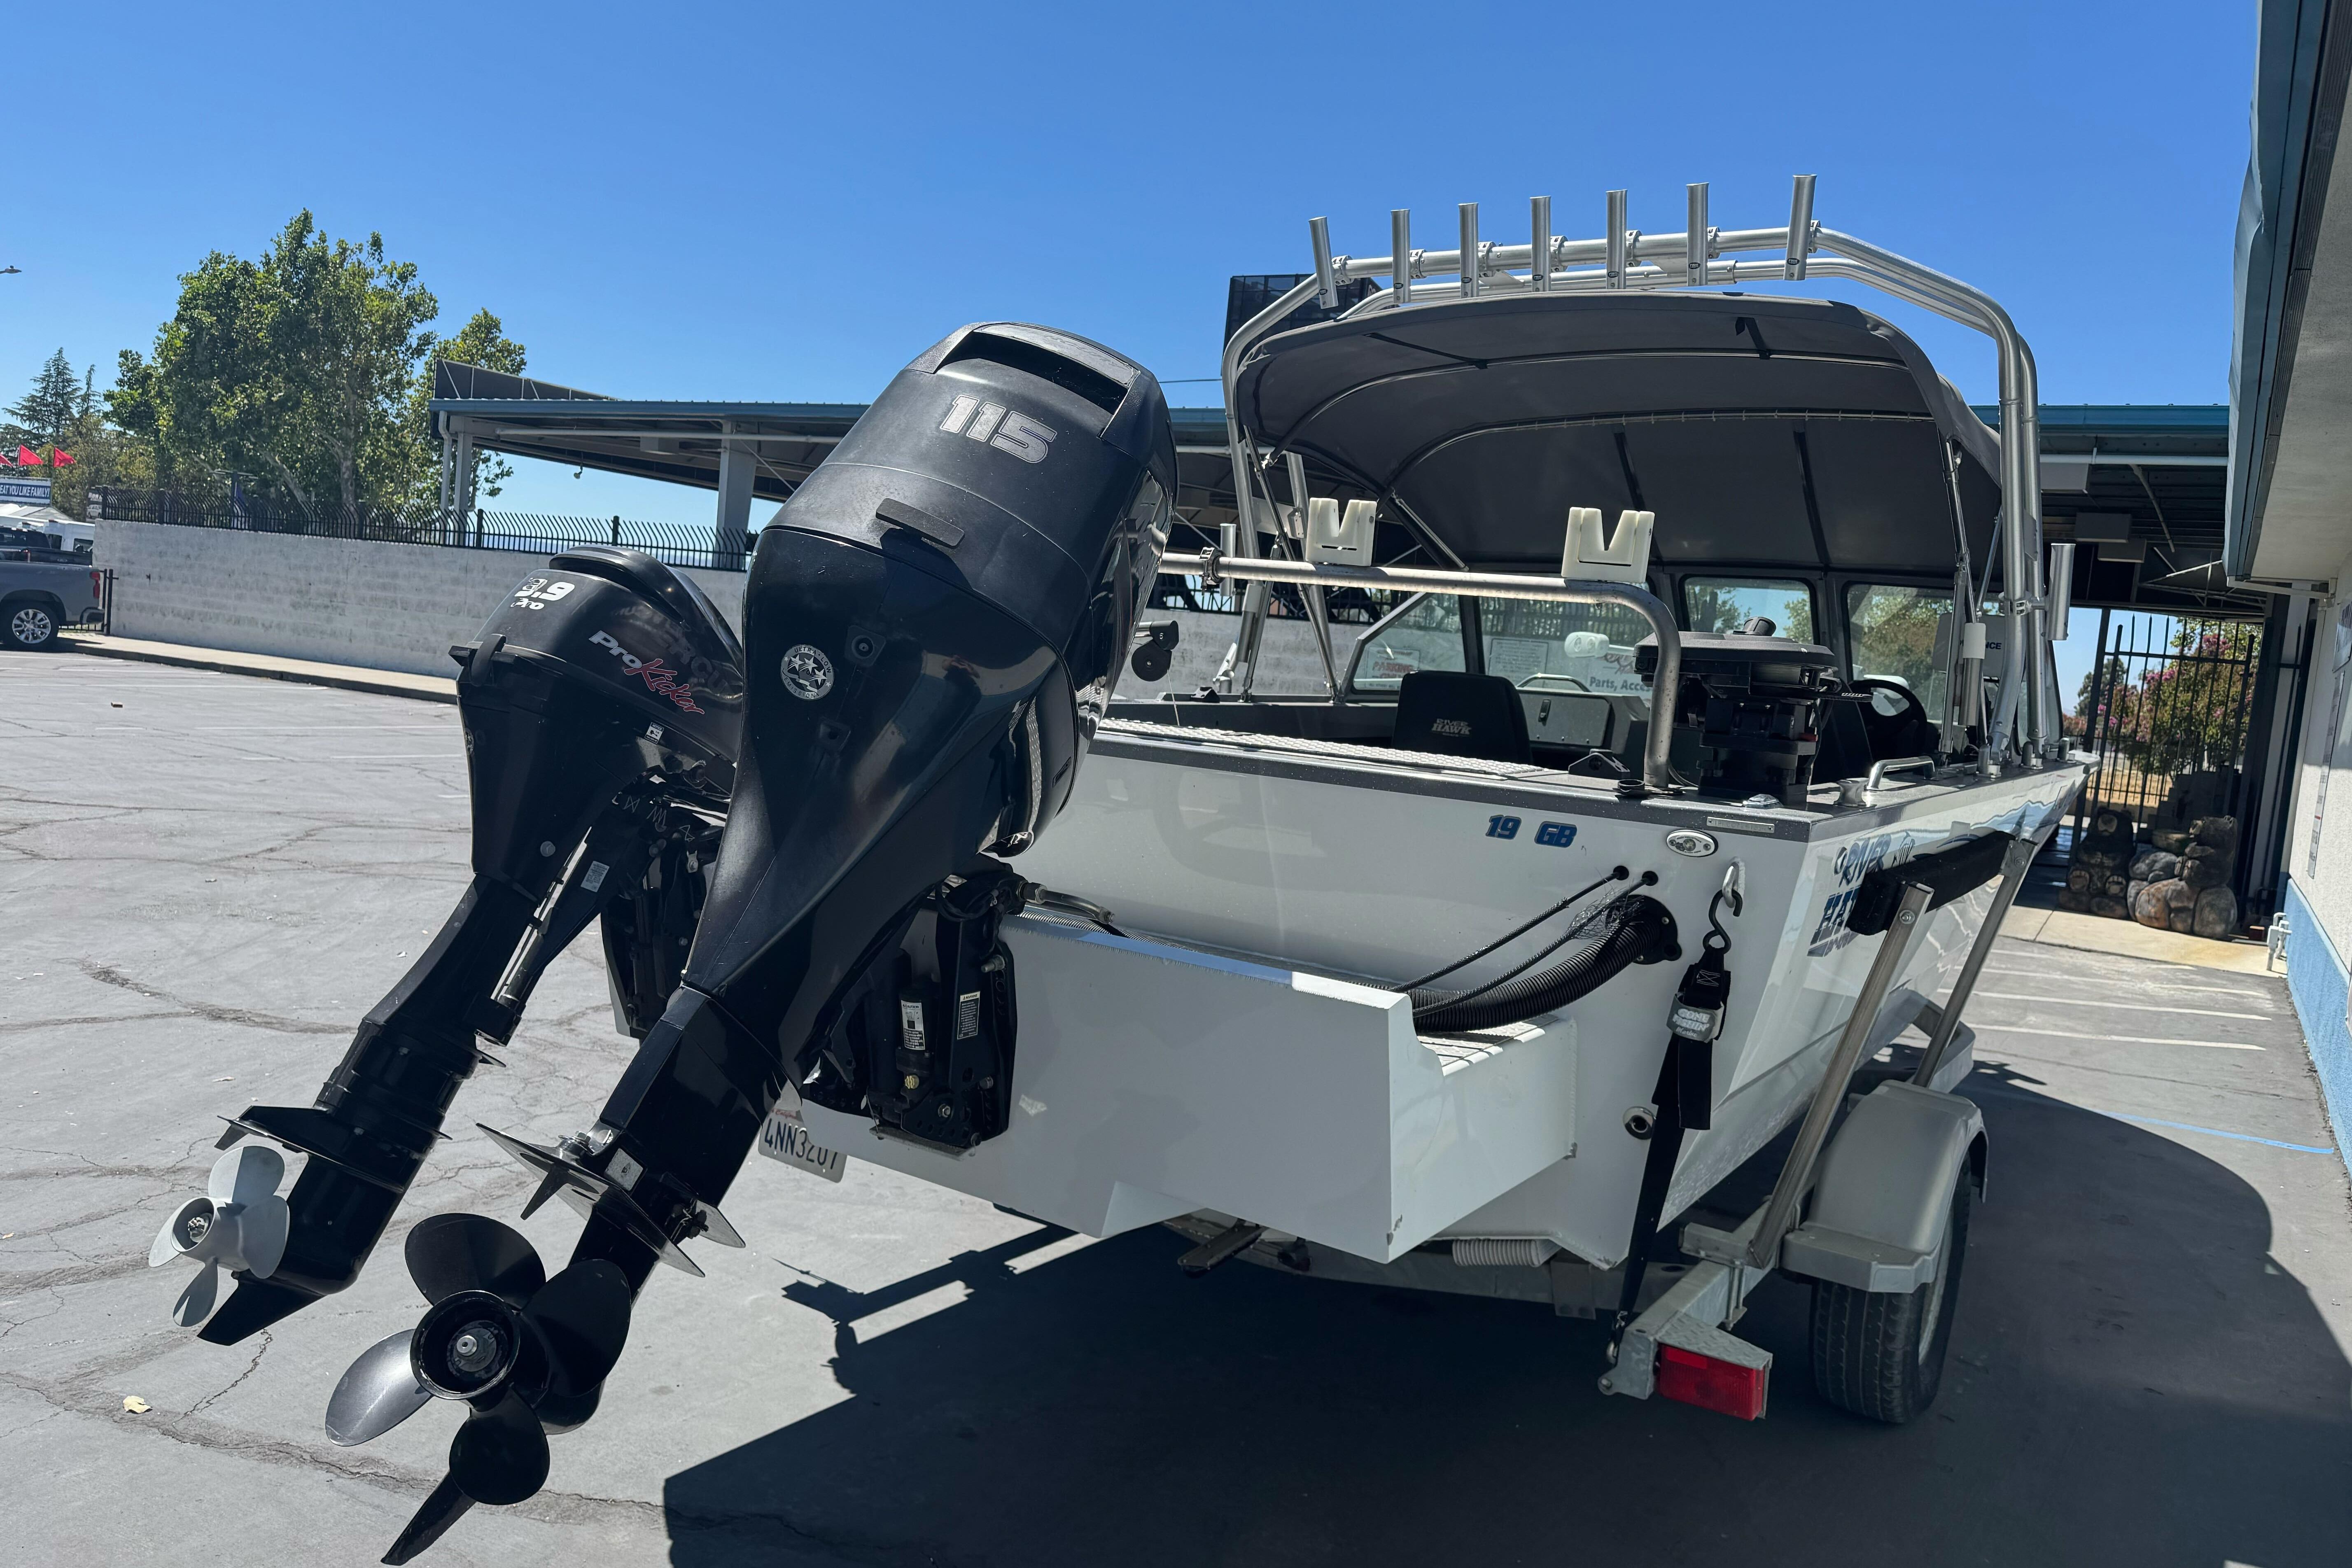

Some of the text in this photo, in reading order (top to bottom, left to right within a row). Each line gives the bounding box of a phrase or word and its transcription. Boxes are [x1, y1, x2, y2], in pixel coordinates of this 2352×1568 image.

[940, 394, 1057, 463] 115
[9, 485, 19, 495] YOU
[20, 486, 30, 496] LIKE
[30, 487, 50, 497] FAMILY!
[821, 657, 831, 673] LOW
[784, 678, 815, 698] EMISSION
[1590, 677, 1617, 691] Parts,
[1431, 723, 1472, 735] HAWK
[1436, 718, 1471, 728] RIVER
[1486, 814, 1521, 840] 19
[1678, 1008, 1710, 1023] GONE
